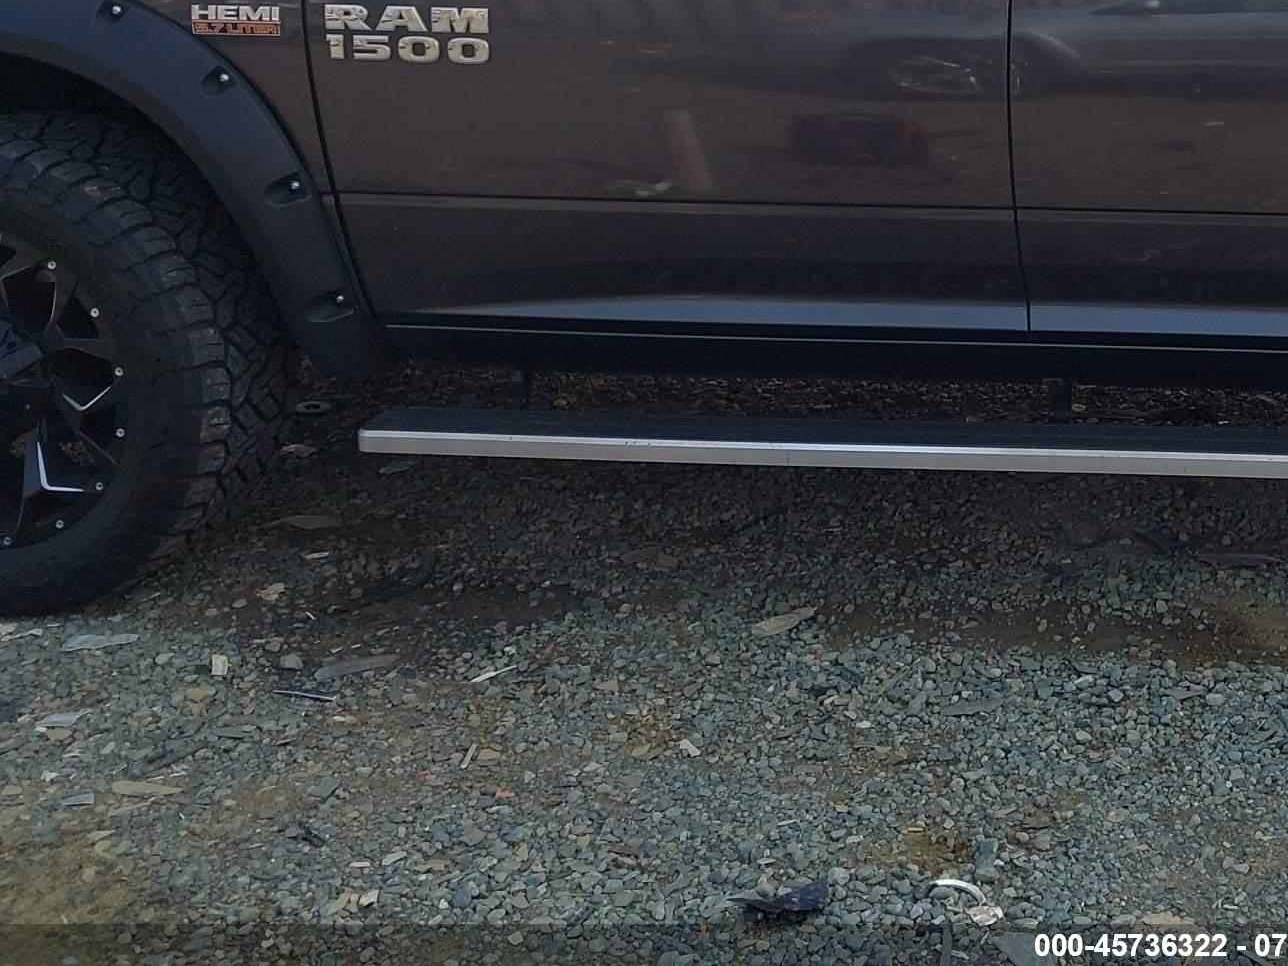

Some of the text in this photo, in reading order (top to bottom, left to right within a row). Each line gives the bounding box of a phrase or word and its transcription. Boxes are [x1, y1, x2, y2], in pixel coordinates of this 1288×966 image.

[191, 4, 280, 21] HEMI
[324, 4, 489, 33] RAM
[325, 34, 490, 65] 1500
